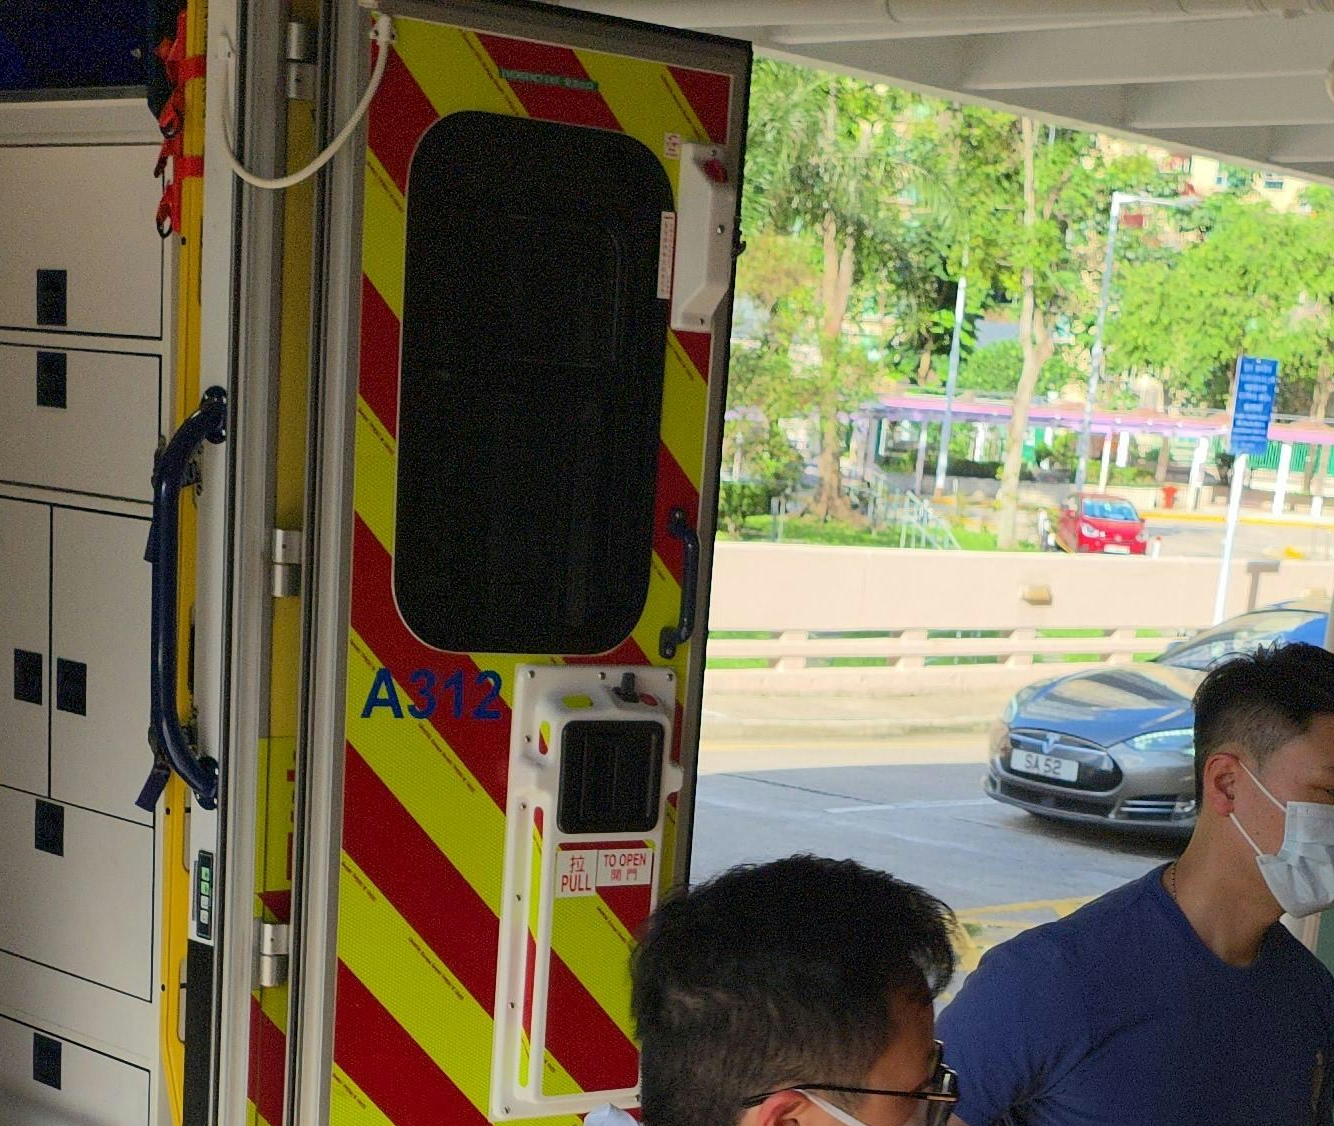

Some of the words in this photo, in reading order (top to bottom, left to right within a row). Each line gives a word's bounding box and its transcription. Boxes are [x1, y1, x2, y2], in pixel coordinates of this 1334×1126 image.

[361, 667, 503, 719] A312
[570, 855, 586, 873] 拉
[604, 854, 616, 867] TO
[620, 853, 646, 867] OPEN
[561, 873, 591, 892] PULL
